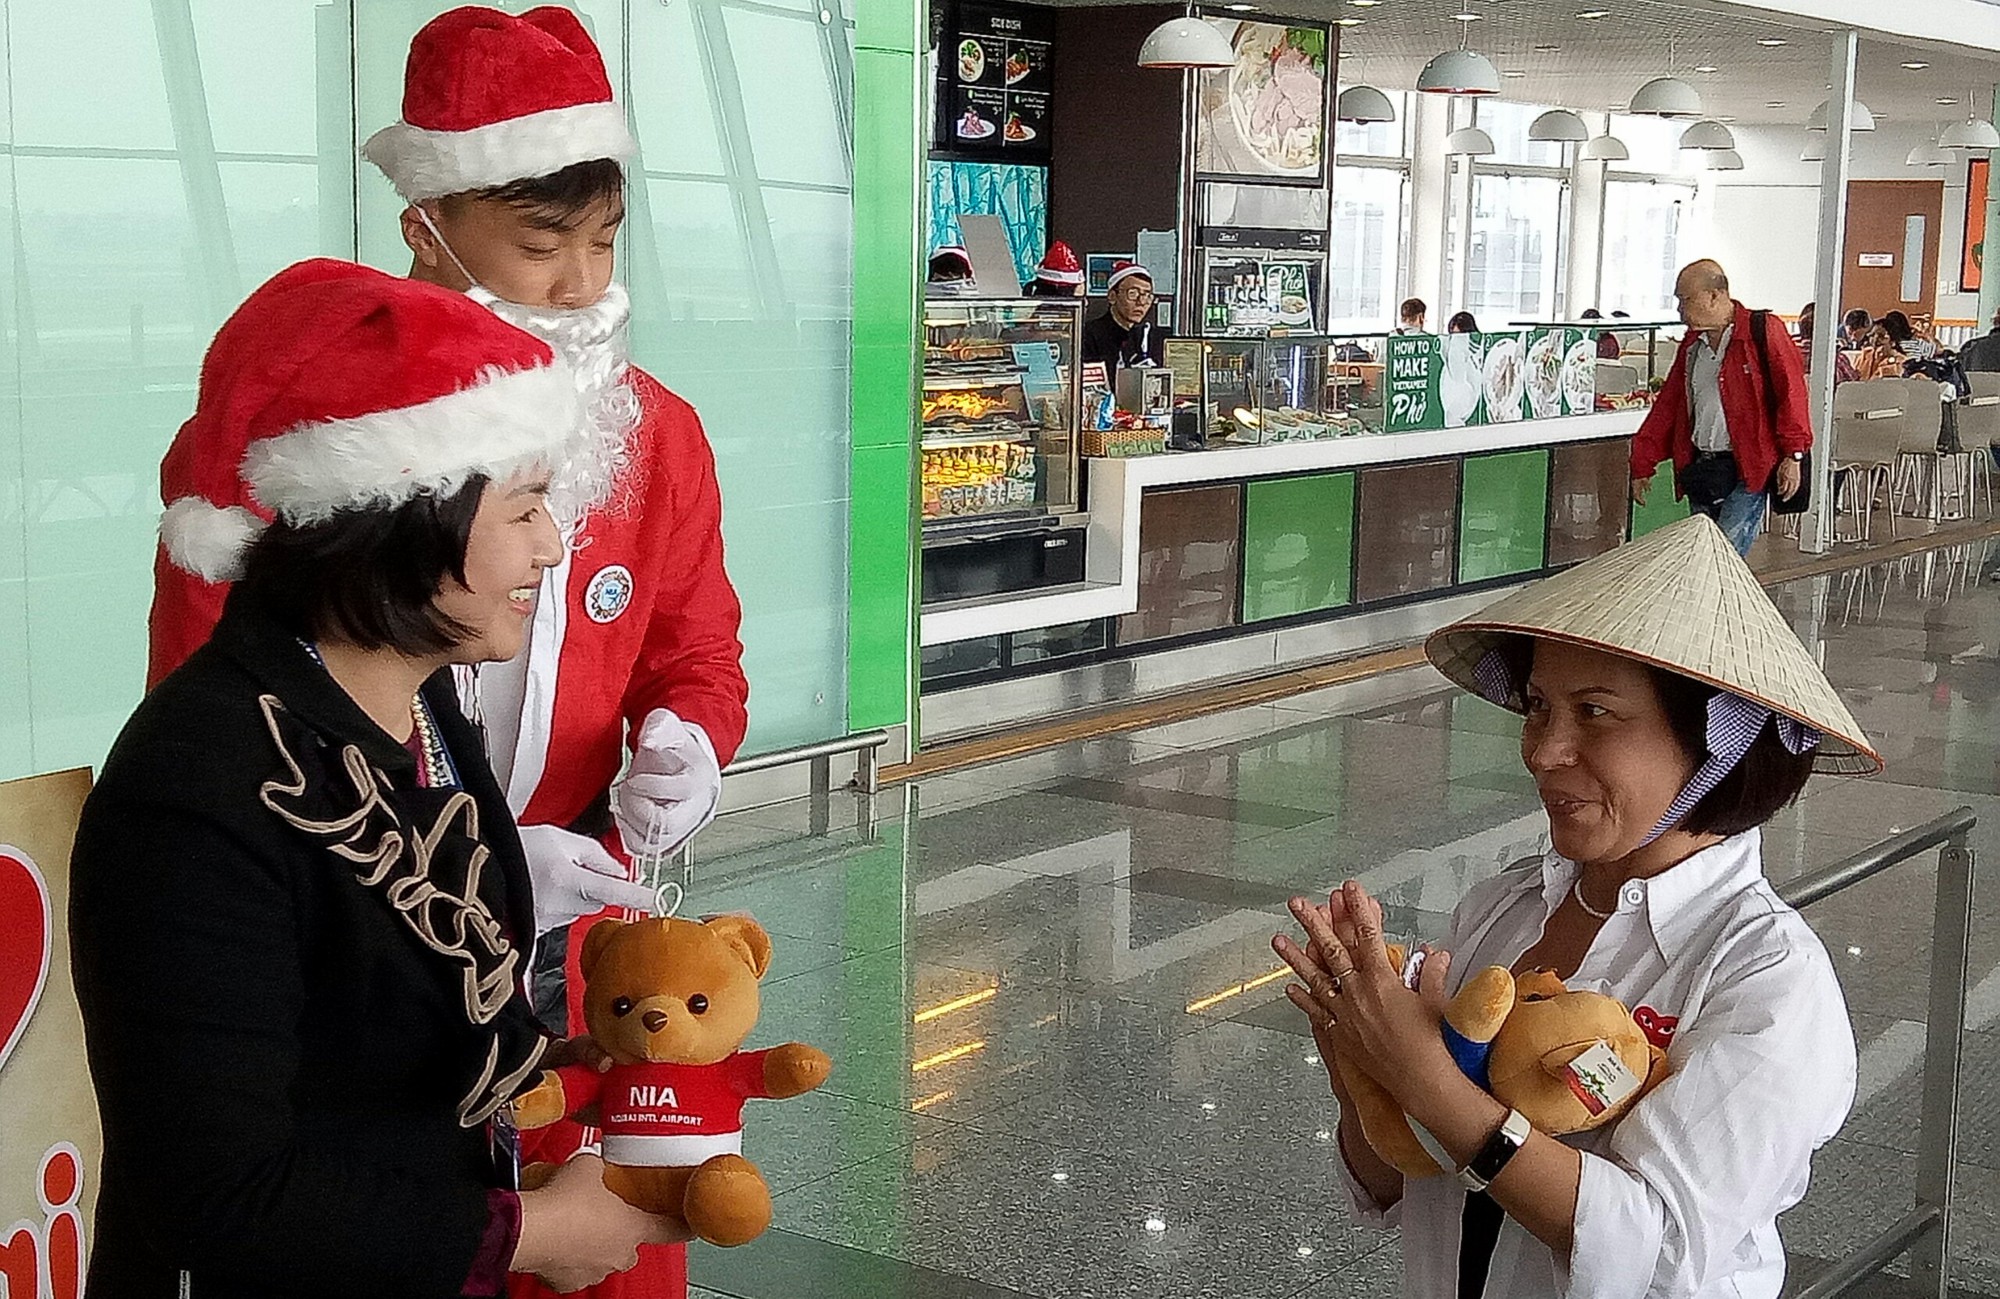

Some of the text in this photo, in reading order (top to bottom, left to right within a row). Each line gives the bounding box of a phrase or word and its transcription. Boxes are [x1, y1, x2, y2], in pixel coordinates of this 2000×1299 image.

[1393, 340, 1430, 356] HOW TO
[1393, 357, 1429, 378] MAKE
[1391, 391, 1427, 425] Phở
[629, 1086, 679, 1109] NIA
[660, 1115, 703, 1126] AIRPORT
